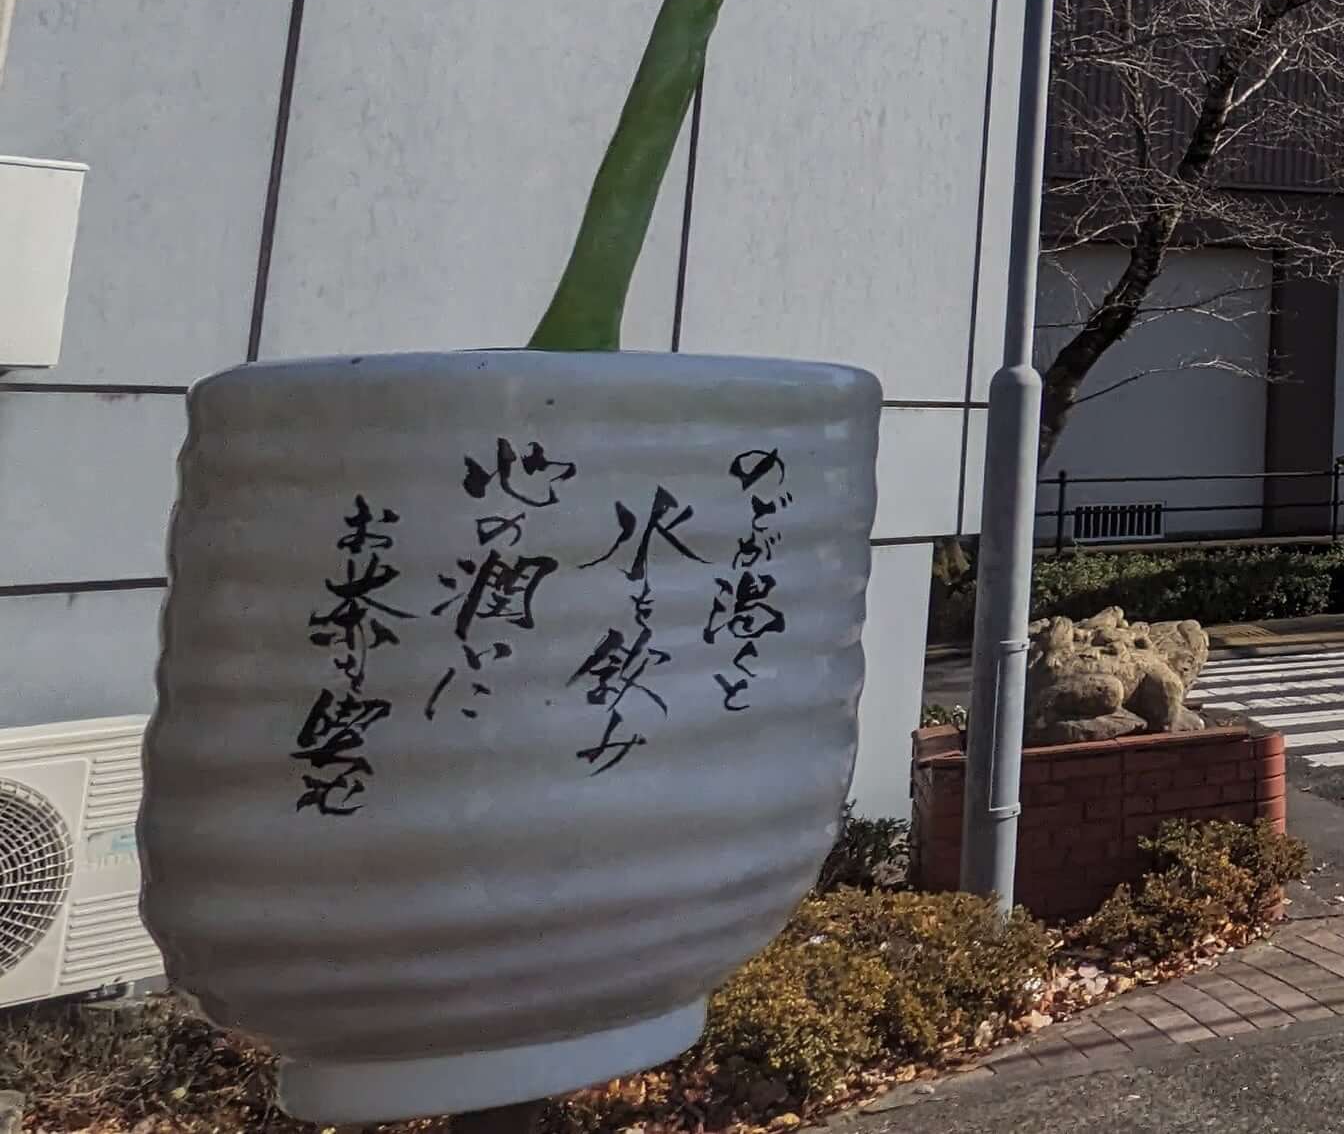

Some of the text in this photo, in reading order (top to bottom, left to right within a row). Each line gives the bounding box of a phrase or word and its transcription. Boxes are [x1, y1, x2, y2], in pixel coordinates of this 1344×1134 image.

[424, 437, 577, 721] 心の潤いに
[565, 484, 713, 777] 水を飲み
